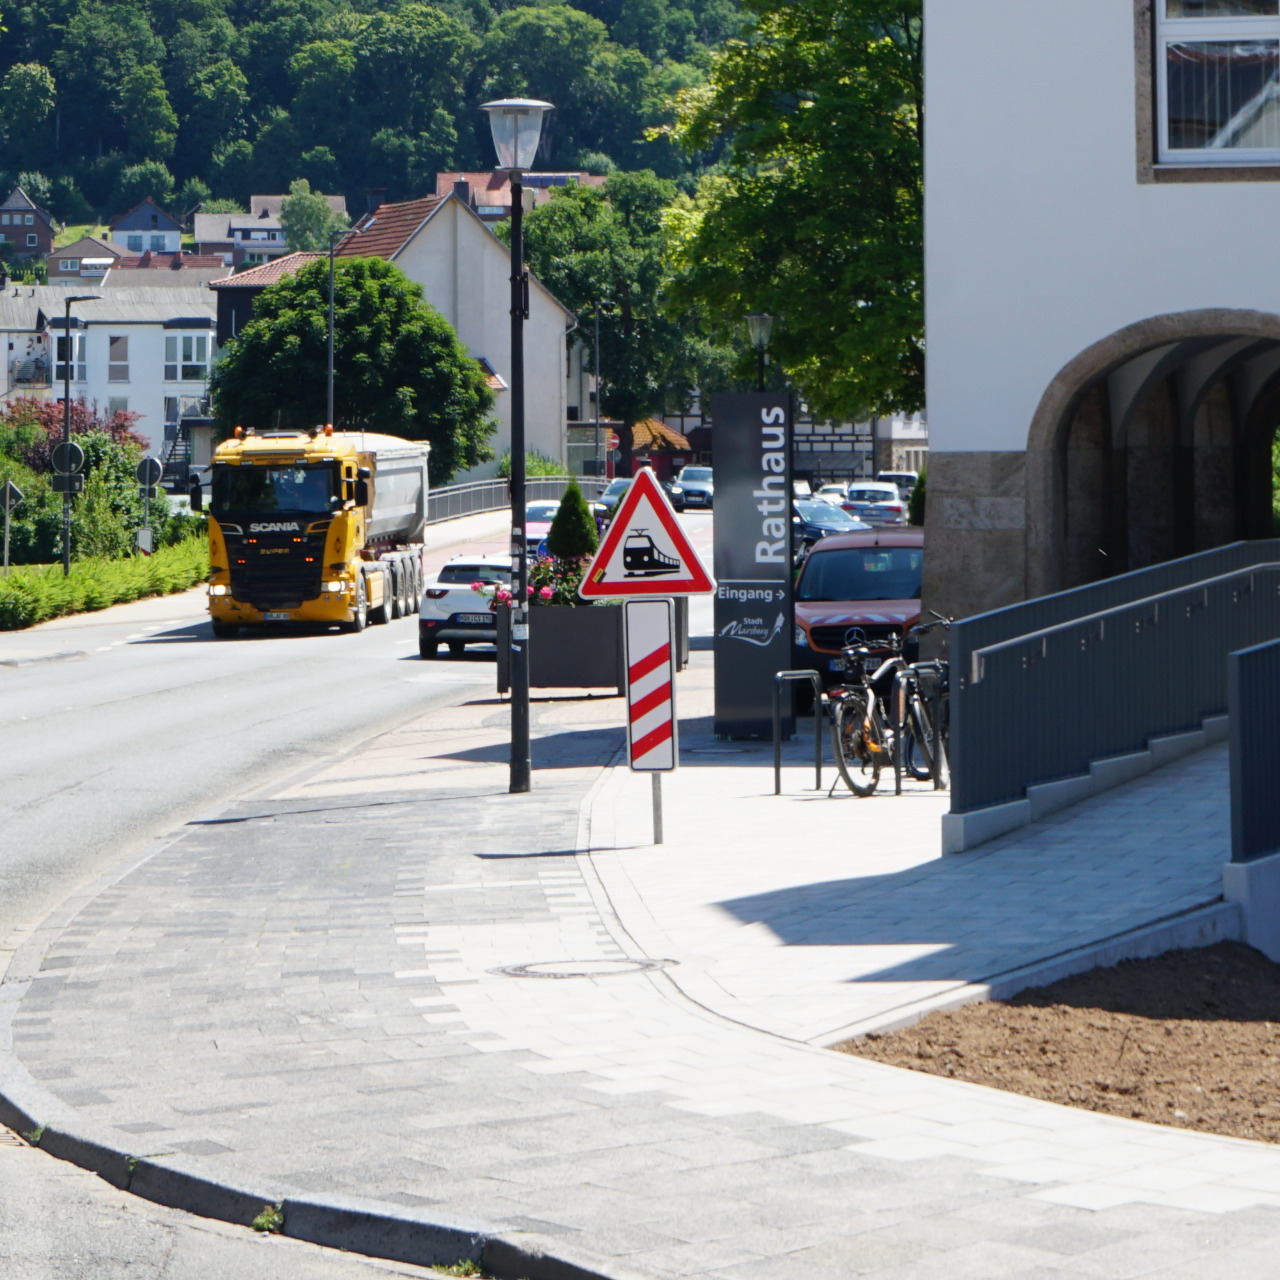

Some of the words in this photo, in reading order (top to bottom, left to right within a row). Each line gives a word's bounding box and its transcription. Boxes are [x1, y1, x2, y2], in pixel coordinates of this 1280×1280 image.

[753, 406, 786, 563] Rathaus
[249, 522, 300, 532] SCANIA
[718, 586, 773, 603] Eingang
[743, 617, 763, 625] Stadt
